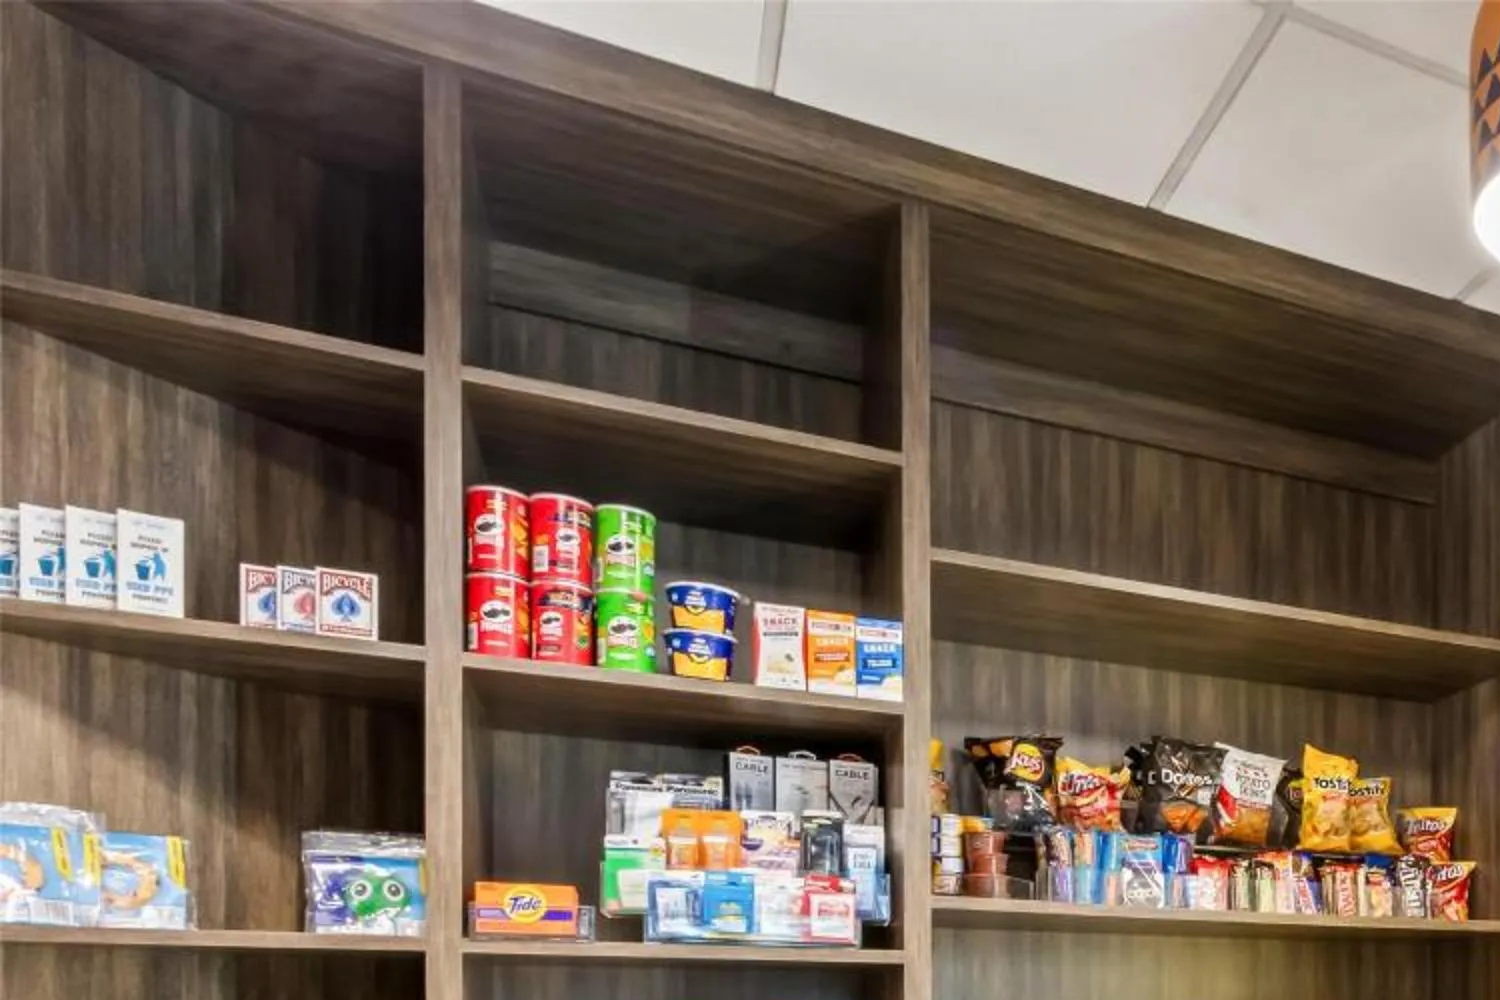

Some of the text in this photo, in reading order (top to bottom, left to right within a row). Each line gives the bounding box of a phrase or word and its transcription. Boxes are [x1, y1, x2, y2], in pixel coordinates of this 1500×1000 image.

[321, 573, 371, 600] BICYCLE
[835, 769, 870, 780] CABLE
[509, 895, 542, 914] Tide
